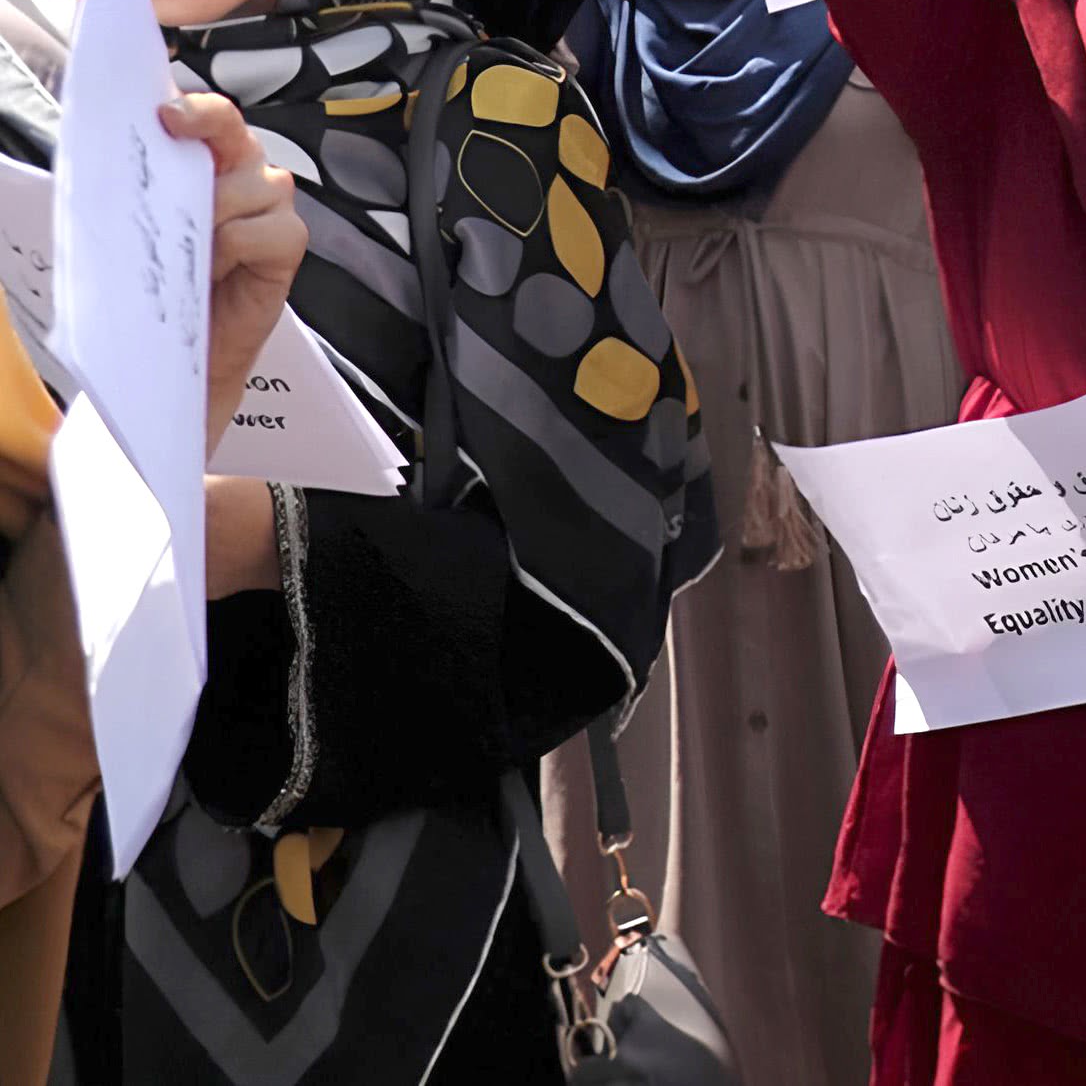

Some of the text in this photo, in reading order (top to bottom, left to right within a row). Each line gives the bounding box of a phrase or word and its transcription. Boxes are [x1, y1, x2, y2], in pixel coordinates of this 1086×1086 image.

[986, 481, 1043, 515] حقوق
[1052, 479, 1068, 498] و
[982, 598, 1085, 636] Equality
